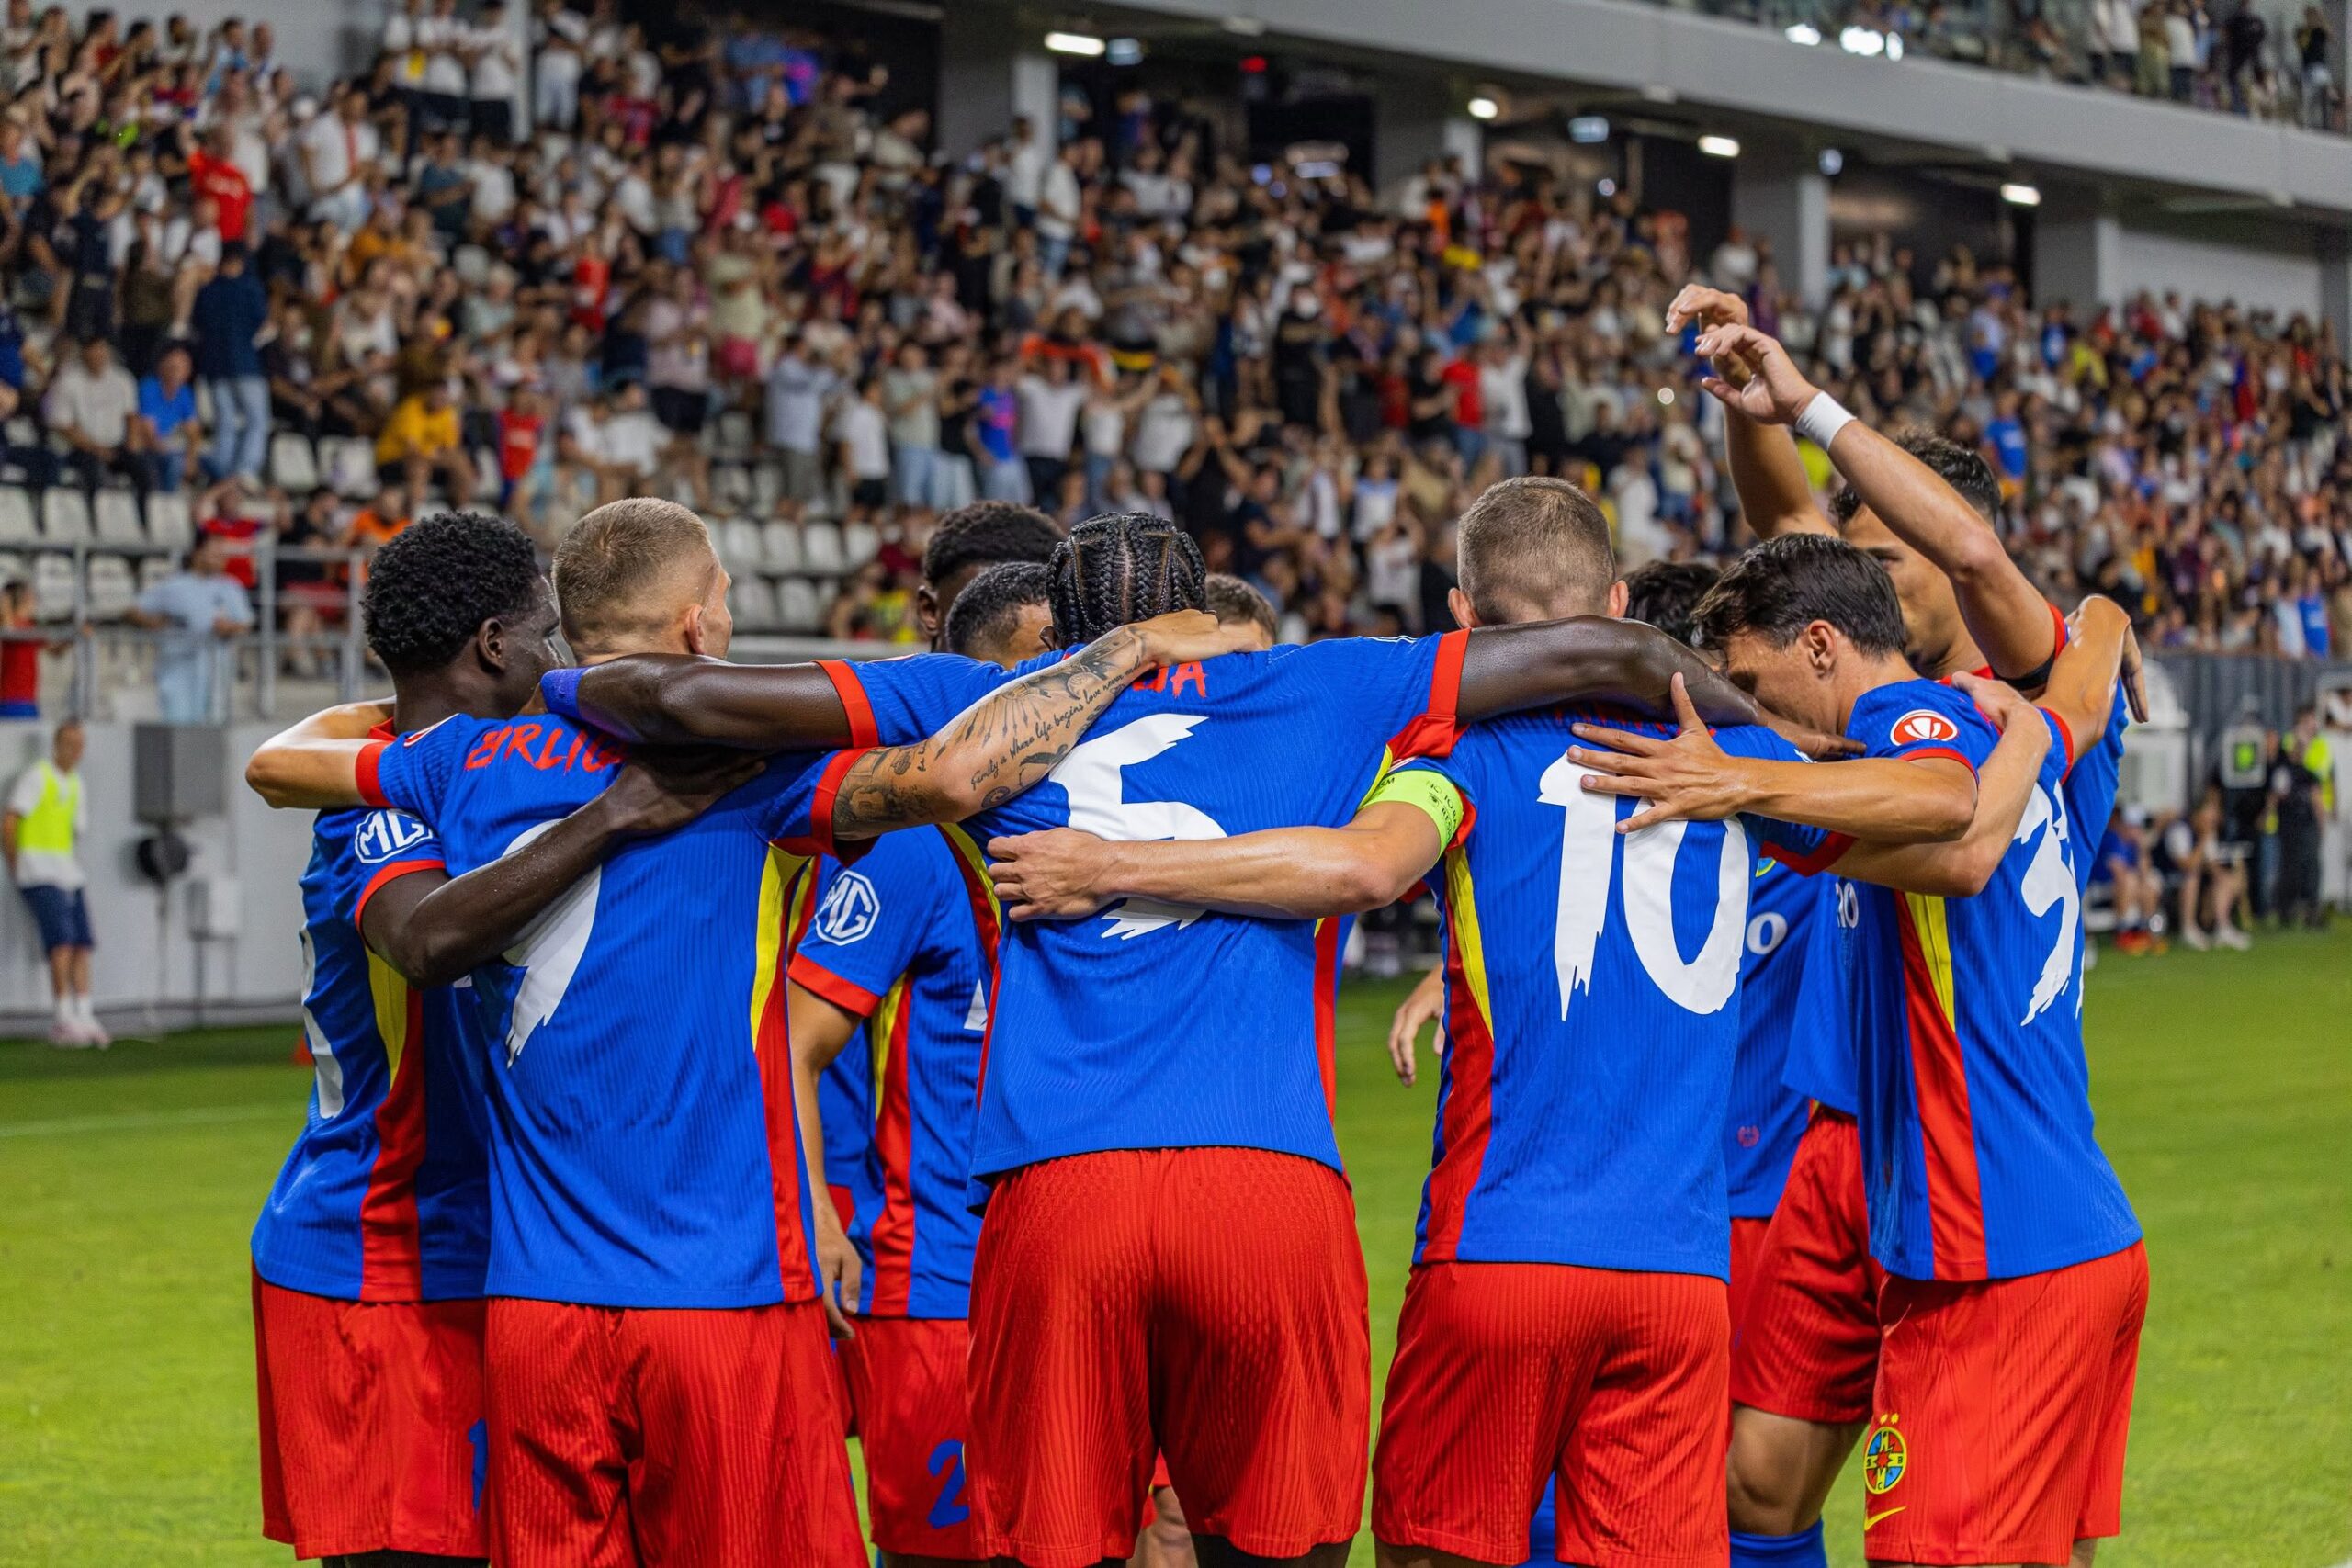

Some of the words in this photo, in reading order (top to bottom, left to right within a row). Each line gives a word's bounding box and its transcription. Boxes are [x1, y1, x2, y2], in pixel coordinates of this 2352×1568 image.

[970, 759, 999, 790] Family
[1035, 722, 1052, 741] life
[1054, 704, 1084, 728] begins
[1083, 690, 1101, 705] love
[359, 808, 425, 856] MG
[1048, 713, 1228, 940] 5
[823, 876, 873, 940] MG
[1537, 744, 1749, 1021] 10
